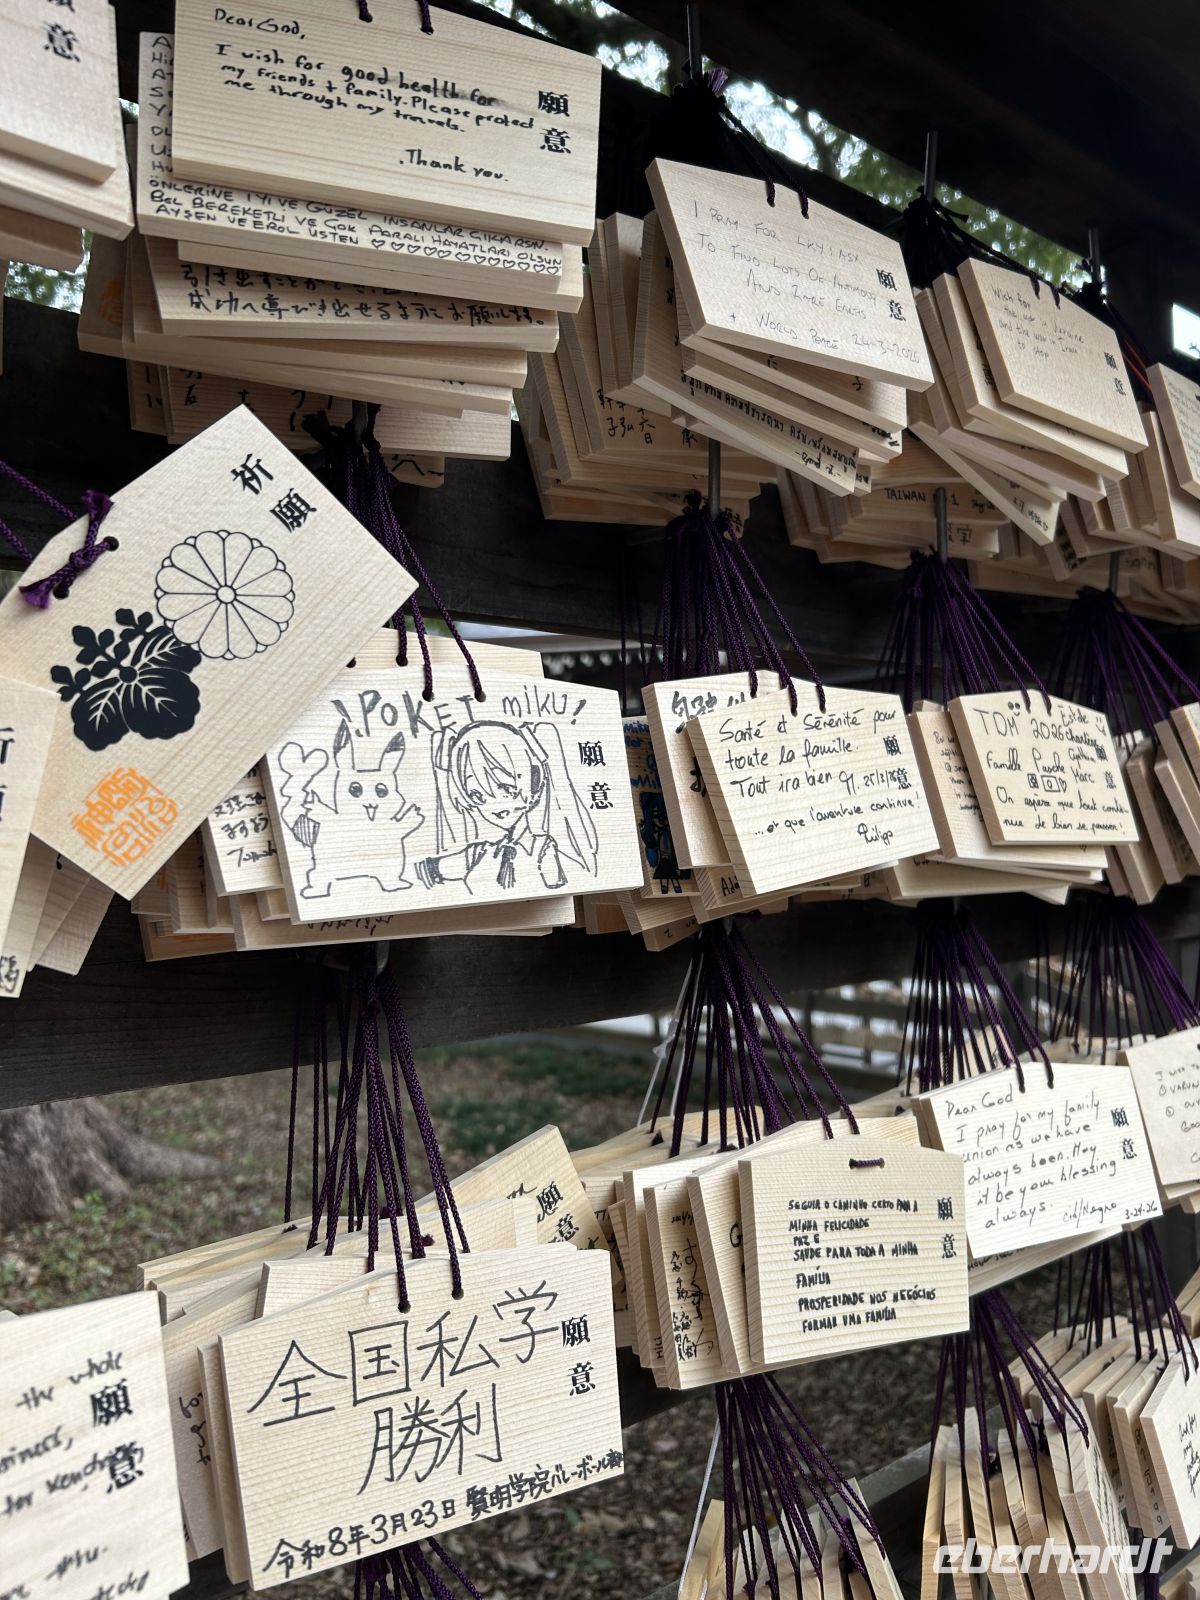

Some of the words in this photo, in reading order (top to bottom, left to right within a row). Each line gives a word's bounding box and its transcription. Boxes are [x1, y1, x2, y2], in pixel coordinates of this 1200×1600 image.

[43, 0, 81, 62] 意
[215, 8, 253, 27] Dear
[215, 43, 232, 56] I
[242, 49, 285, 64] wish
[295, 55, 325, 70] for
[341, 67, 389, 84] good
[398, 71, 460, 99] health
[470, 88, 499, 107] for
[221, 64, 245, 79] my
[412, 96, 471, 118] Please
[475, 113, 535, 129] protect
[224, 79, 256, 91] me
[268, 85, 348, 109] through
[356, 103, 385, 116] my
[538, 90, 572, 154] 願意
[473, 165, 509, 181] you.
[277, 196, 298, 209] VE
[227, 216, 246, 227] VE
[253, 221, 301, 235] EROL
[876, 268, 907, 322] 願意
[230, 453, 318, 533] 祈願
[884, 487, 926, 503] TAIWAN
[718, 718, 767, 742] Santé
[873, 709, 897, 735] pour
[1030, 717, 1065, 742] 2026
[577, 740, 614, 811] 願意
[724, 748, 769, 770] toute
[778, 745, 796, 765] la
[730, 775, 771, 798] Tout
[778, 773, 801, 792] ira
[805, 769, 833, 787] bien
[996, 786, 1015, 804] On
[784, 816, 806, 834] que
[945, 1100, 977, 1119] Dear
[981, 1083, 1014, 1109] God
[956, 1124, 968, 1143] I
[976, 1121, 1005, 1147] pray
[1012, 1110, 1032, 1141] for
[1038, 1107, 1054, 1131] my
[1063, 1089, 1100, 1126] family
[1056, 1122, 1092, 1138] have
[1111, 1107, 1138, 1161] 願意
[968, 1163, 1022, 1187] always
[1072, 1141, 1097, 1168] May
[976, 1187, 990, 1206] it
[995, 1182, 1015, 1204] be
[1060, 1158, 1117, 1182] blessing
[788, 1199, 821, 1211] SEGUIR
[824, 1200, 830, 1209] O
[833, 1199, 868, 1211] CAMINHO
[872, 1199, 894, 1210] CERTO
[788, 1218, 818, 1232] MINHA
[824, 1218, 870, 1232] FELICIDADE
[793, 1234, 811, 1246] PAZ
[814, 1233, 820, 1244] E
[937, 1196, 957, 1260] 願意
[825, 1246, 852, 1259] PARA
[855, 1246, 876, 1258] TODA
[878, 1243, 885, 1257] A
[891, 1240, 919, 1257] MINHA
[798, 1291, 865, 1313] PROSPERIDADE
[870, 1290, 888, 1305] NOS
[802, 1315, 838, 1333] FORMAR
[247, 1280, 560, 1428] 全国私学
[561, 1314, 596, 1398] 願意
[90, 1378, 144, 1494] 願意
[357, 1382, 503, 1496] 勝利
[262, 1499, 457, 1579] 令和8年3月23日
